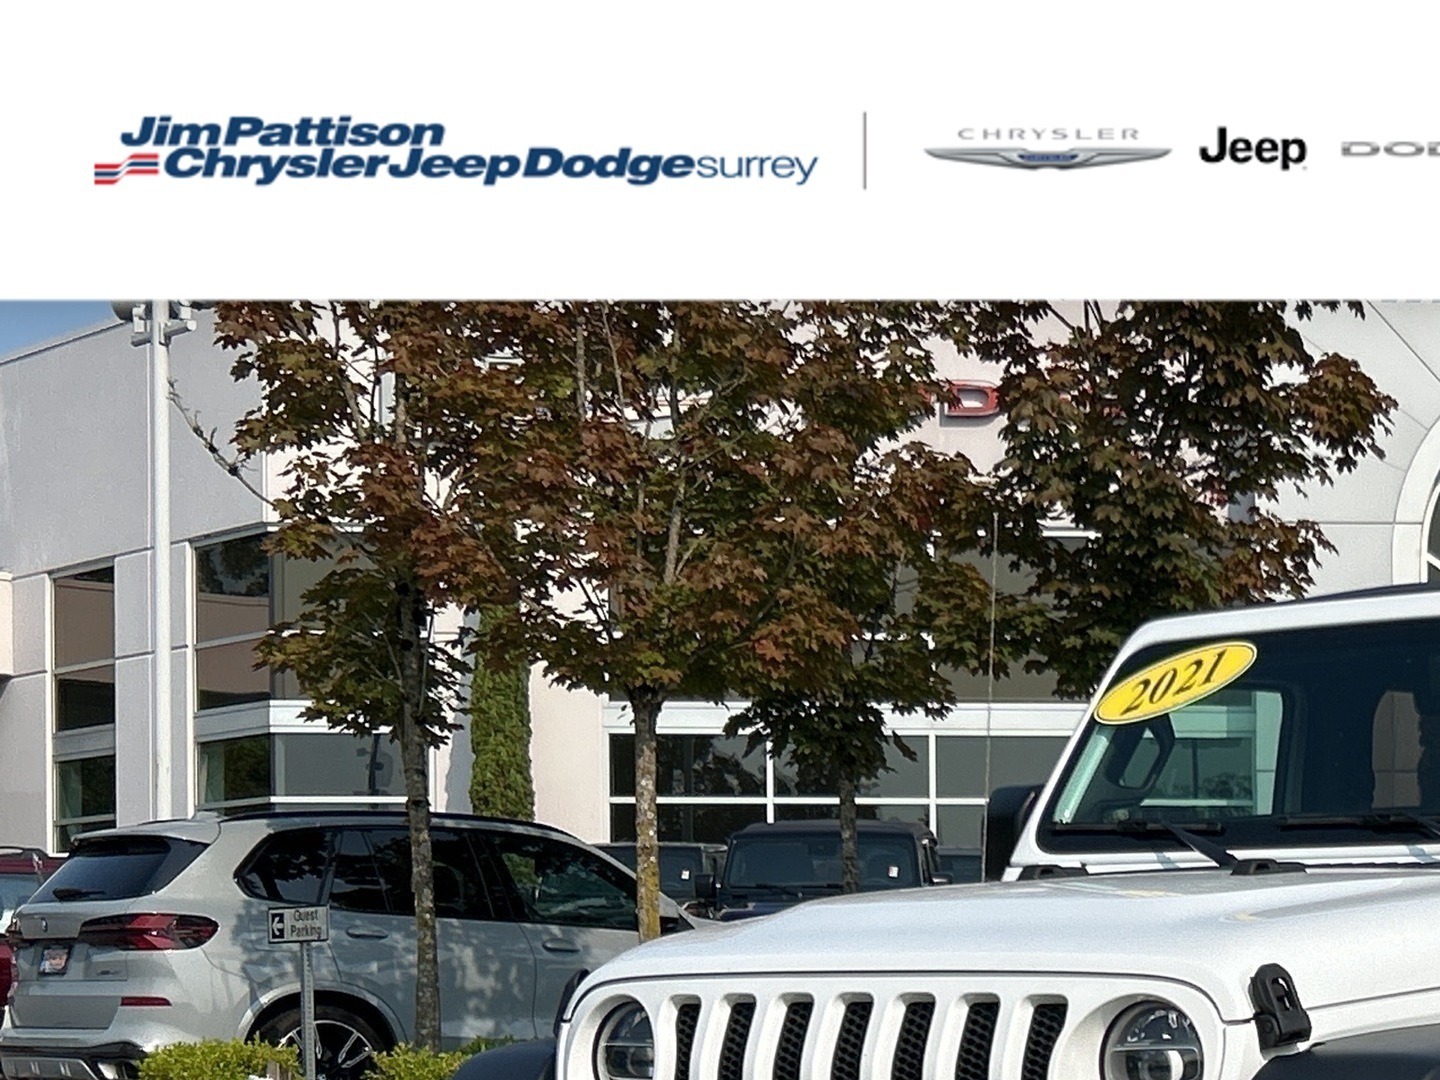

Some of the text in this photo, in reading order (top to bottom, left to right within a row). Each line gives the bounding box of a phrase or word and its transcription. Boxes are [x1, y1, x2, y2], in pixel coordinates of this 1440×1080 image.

[1120, 648, 1228, 716] 2021
[293, 909, 319, 922] Guest
[290, 923, 323, 939] Parking
